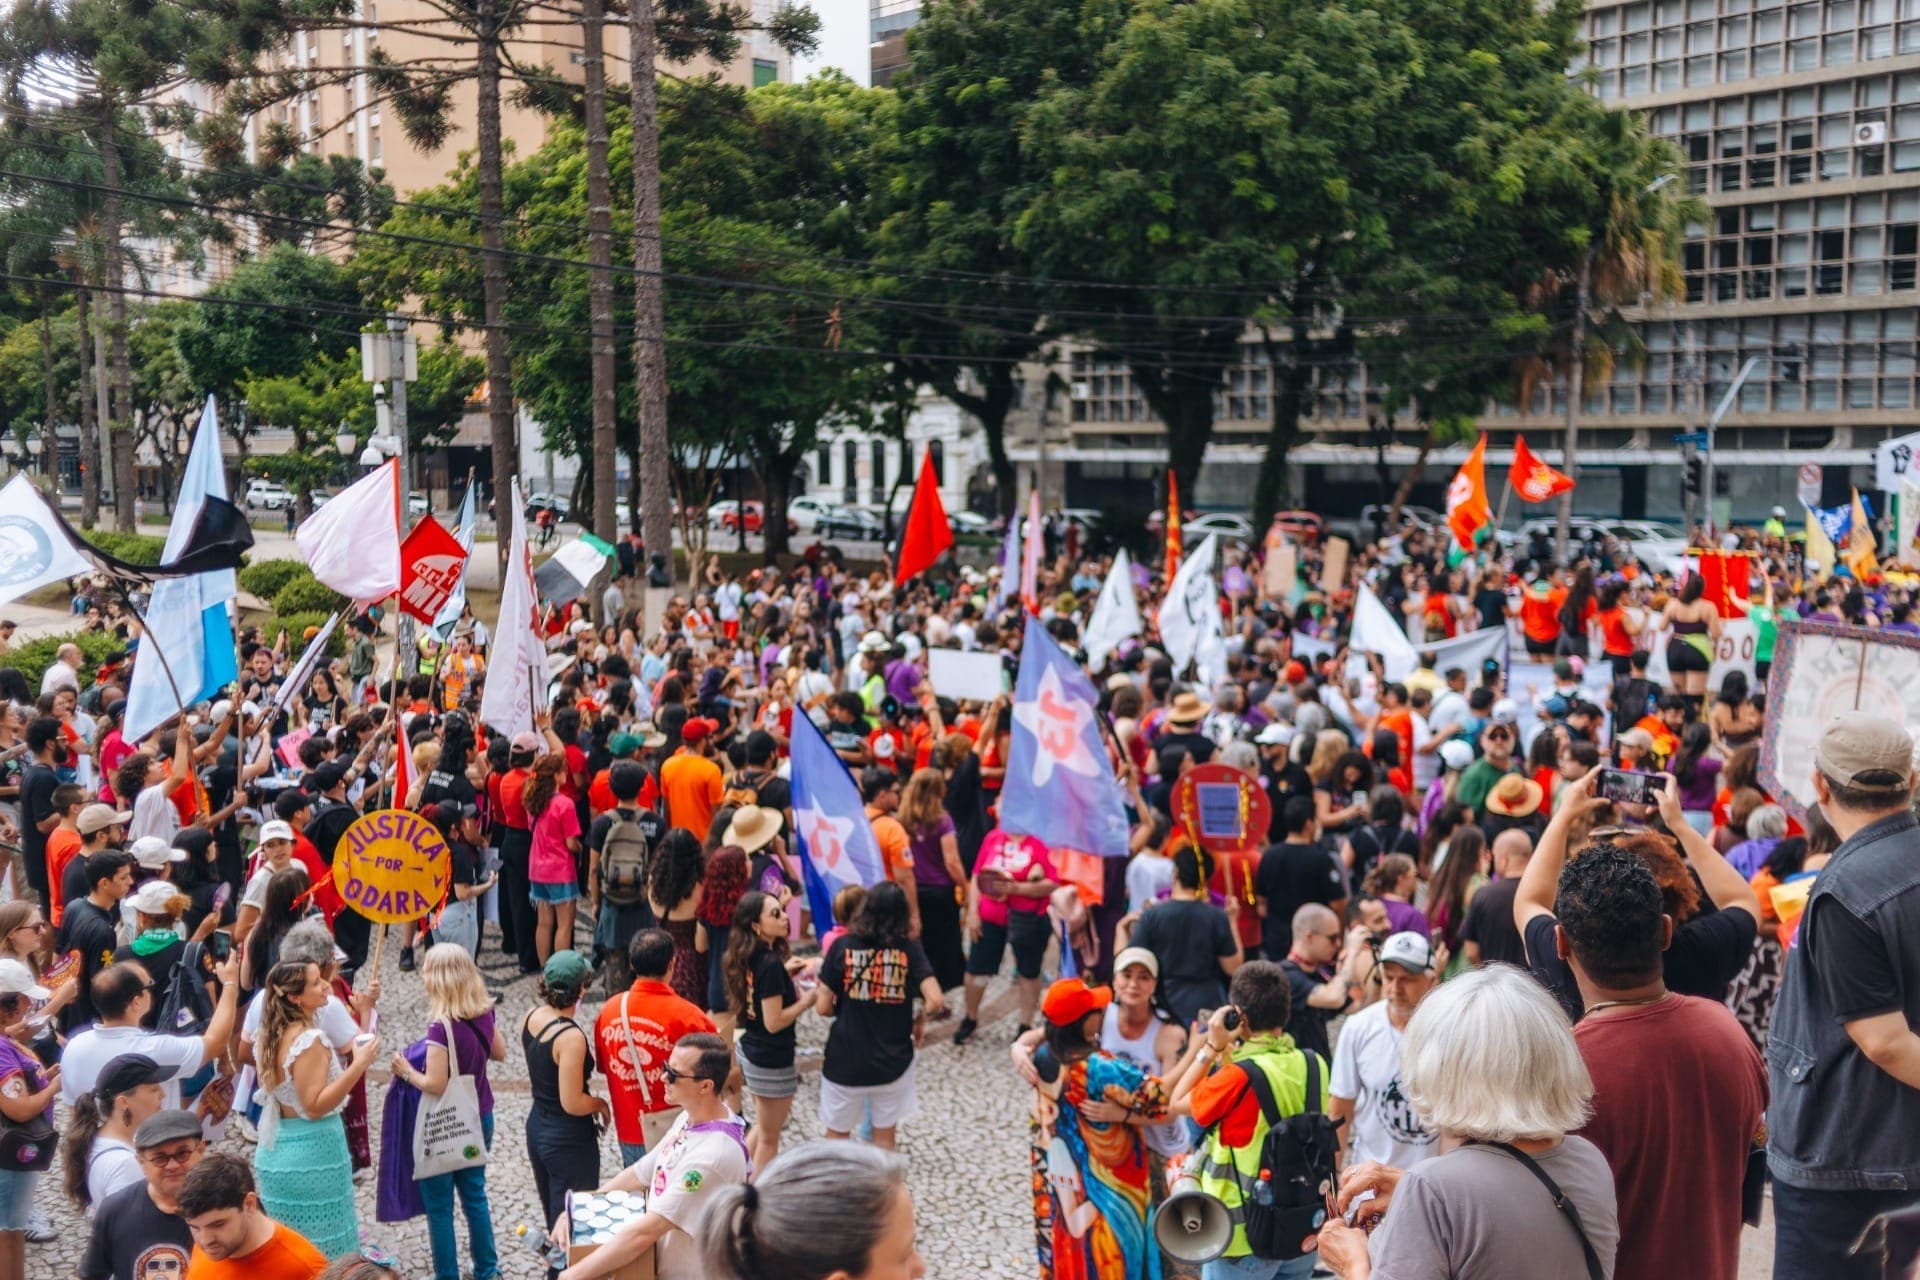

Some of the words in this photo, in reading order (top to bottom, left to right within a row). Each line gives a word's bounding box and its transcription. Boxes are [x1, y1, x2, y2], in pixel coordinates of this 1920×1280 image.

[346, 814, 446, 863] JUSTIÇA
[374, 855, 404, 872] POR
[344, 877, 431, 916] ODARA
